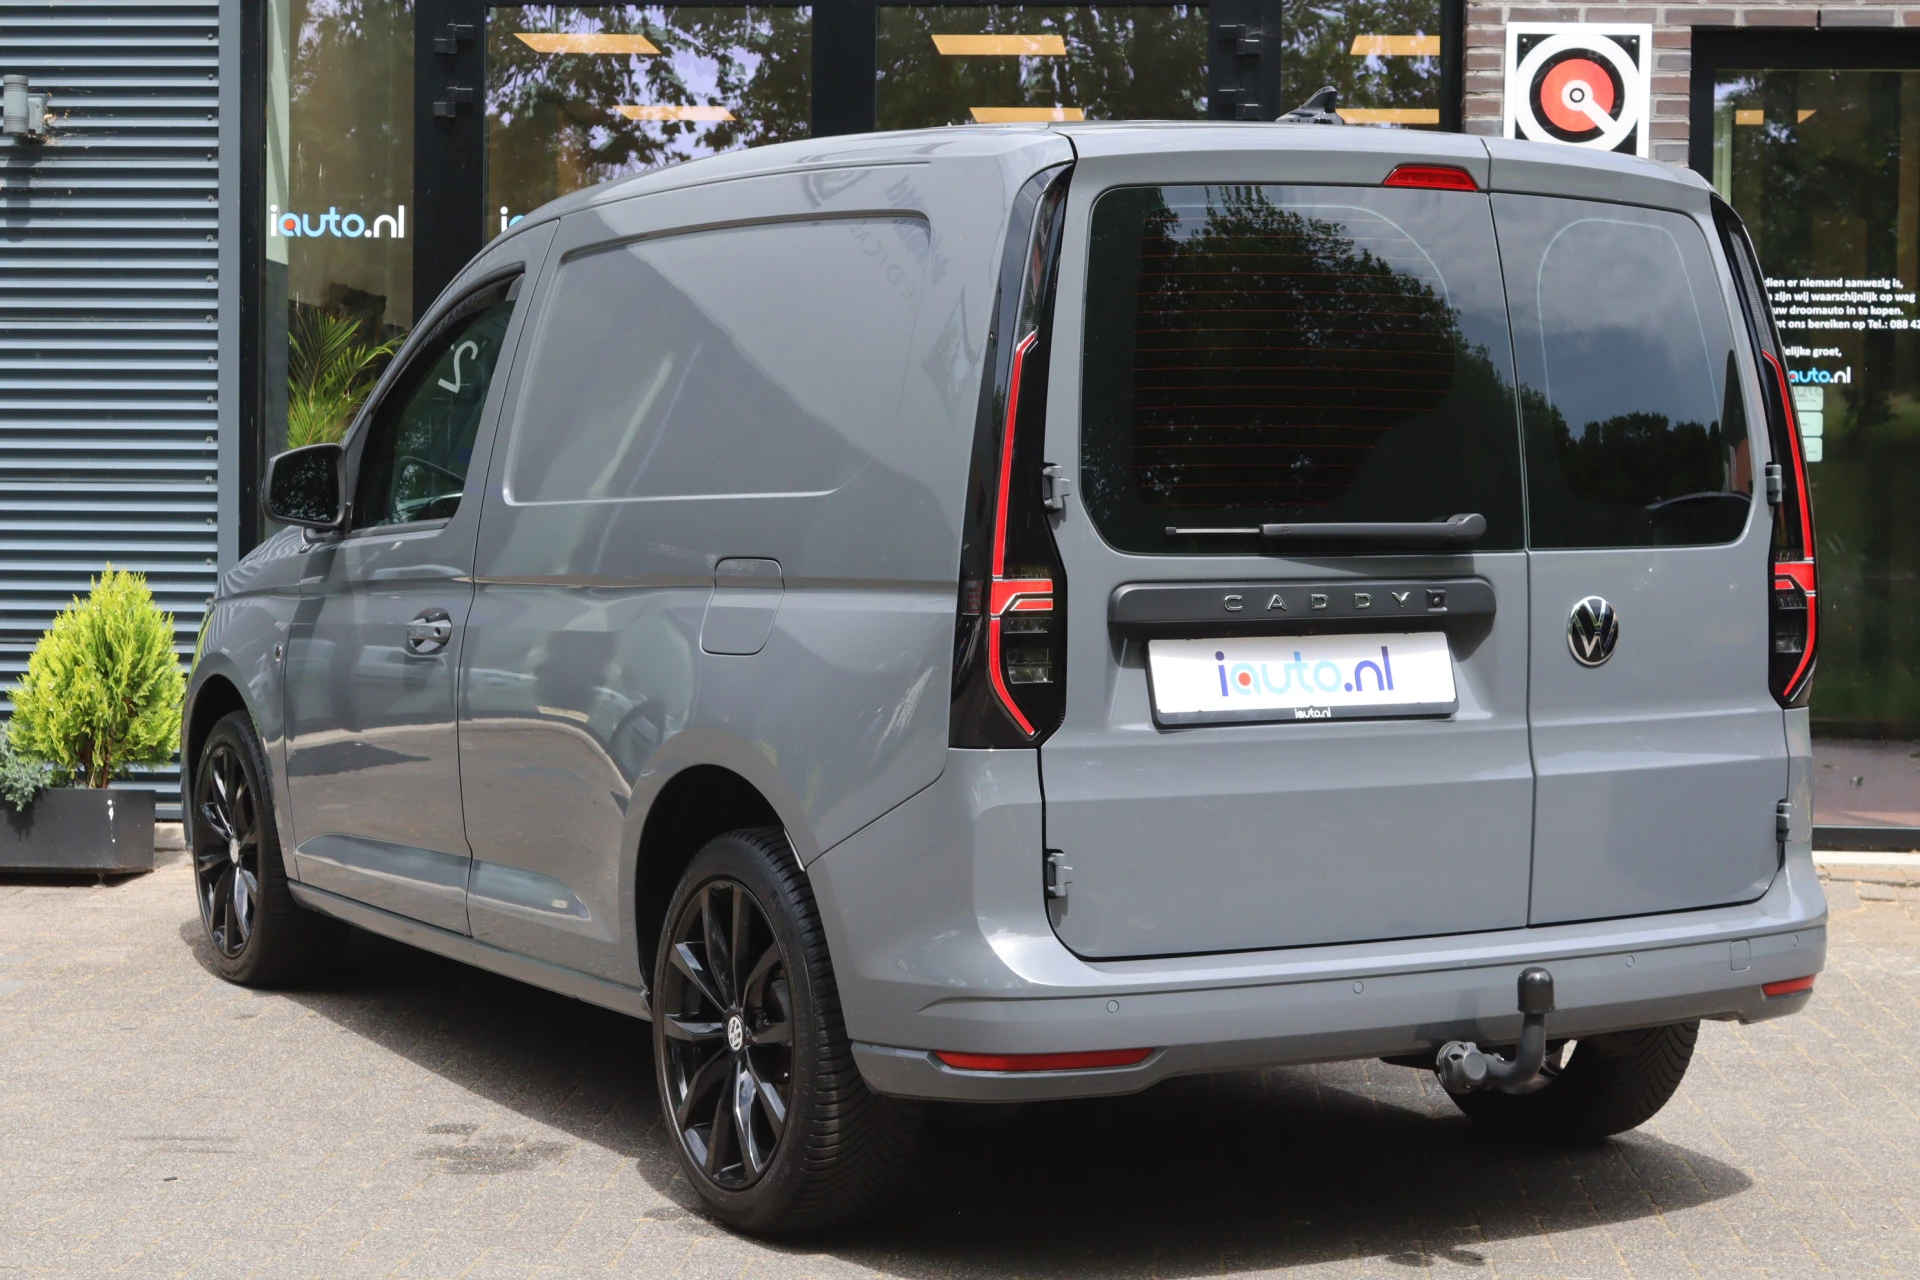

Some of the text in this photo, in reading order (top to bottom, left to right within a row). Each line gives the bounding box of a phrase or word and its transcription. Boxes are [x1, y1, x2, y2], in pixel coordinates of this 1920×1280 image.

[270, 204, 405, 238] iauto.nl
[1787, 279, 1798, 287] er
[1800, 277, 1843, 287] niemand
[1844, 277, 1891, 289] aanwezig
[1892, 277, 1904, 289] is,
[1774, 291, 1792, 303] zijn
[1793, 291, 1809, 303] wij
[1811, 291, 1878, 303] waarschijnlijk
[1879, 293, 1893, 303] op
[1894, 293, 1916, 303] weg
[1789, 305, 1844, 315] droomauto
[1846, 305, 1856, 315] in
[1858, 306, 1869, 315] te
[1870, 305, 1904, 317] kopen.
[1788, 320, 1806, 329] ons
[1808, 319, 1850, 329] bereiken
[1852, 320, 1866, 331] op
[1867, 319, 1888, 329] Tel.:
[1889, 319, 1909, 329] 088
[1812, 347, 1842, 358] groet,
[1224, 591, 1411, 612] CADDY
[1214, 645, 1394, 697] iauto.nl
